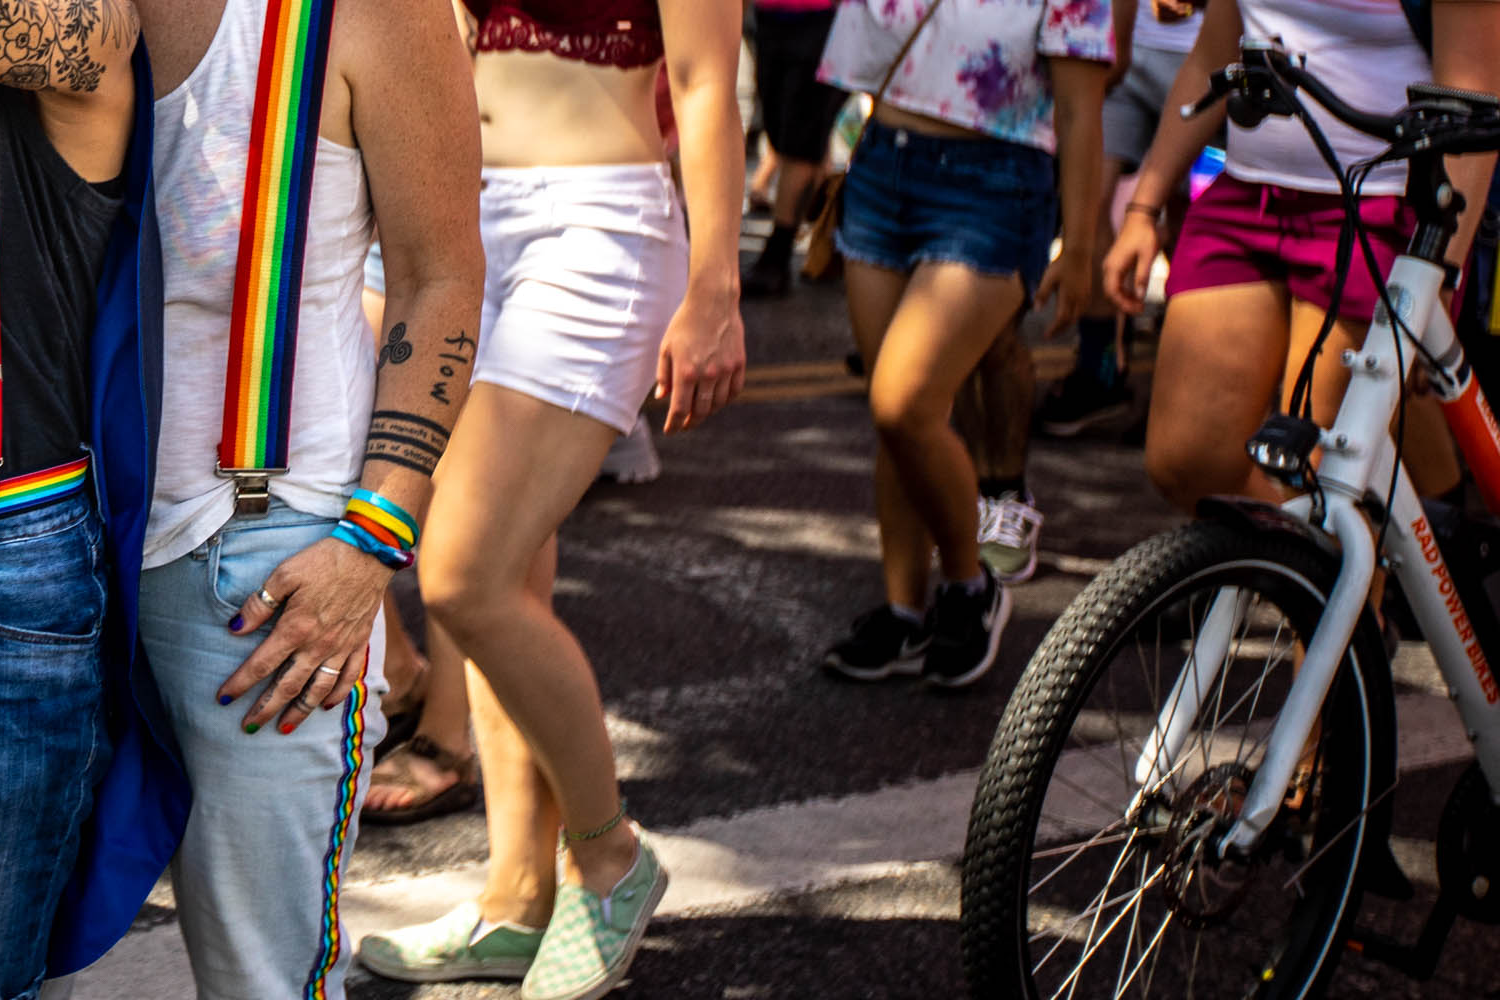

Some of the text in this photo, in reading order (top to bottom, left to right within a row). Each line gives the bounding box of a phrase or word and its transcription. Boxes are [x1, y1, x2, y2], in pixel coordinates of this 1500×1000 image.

[430, 329, 476, 405] flow
[1411, 515, 1500, 705] RAD POWER BIKES
